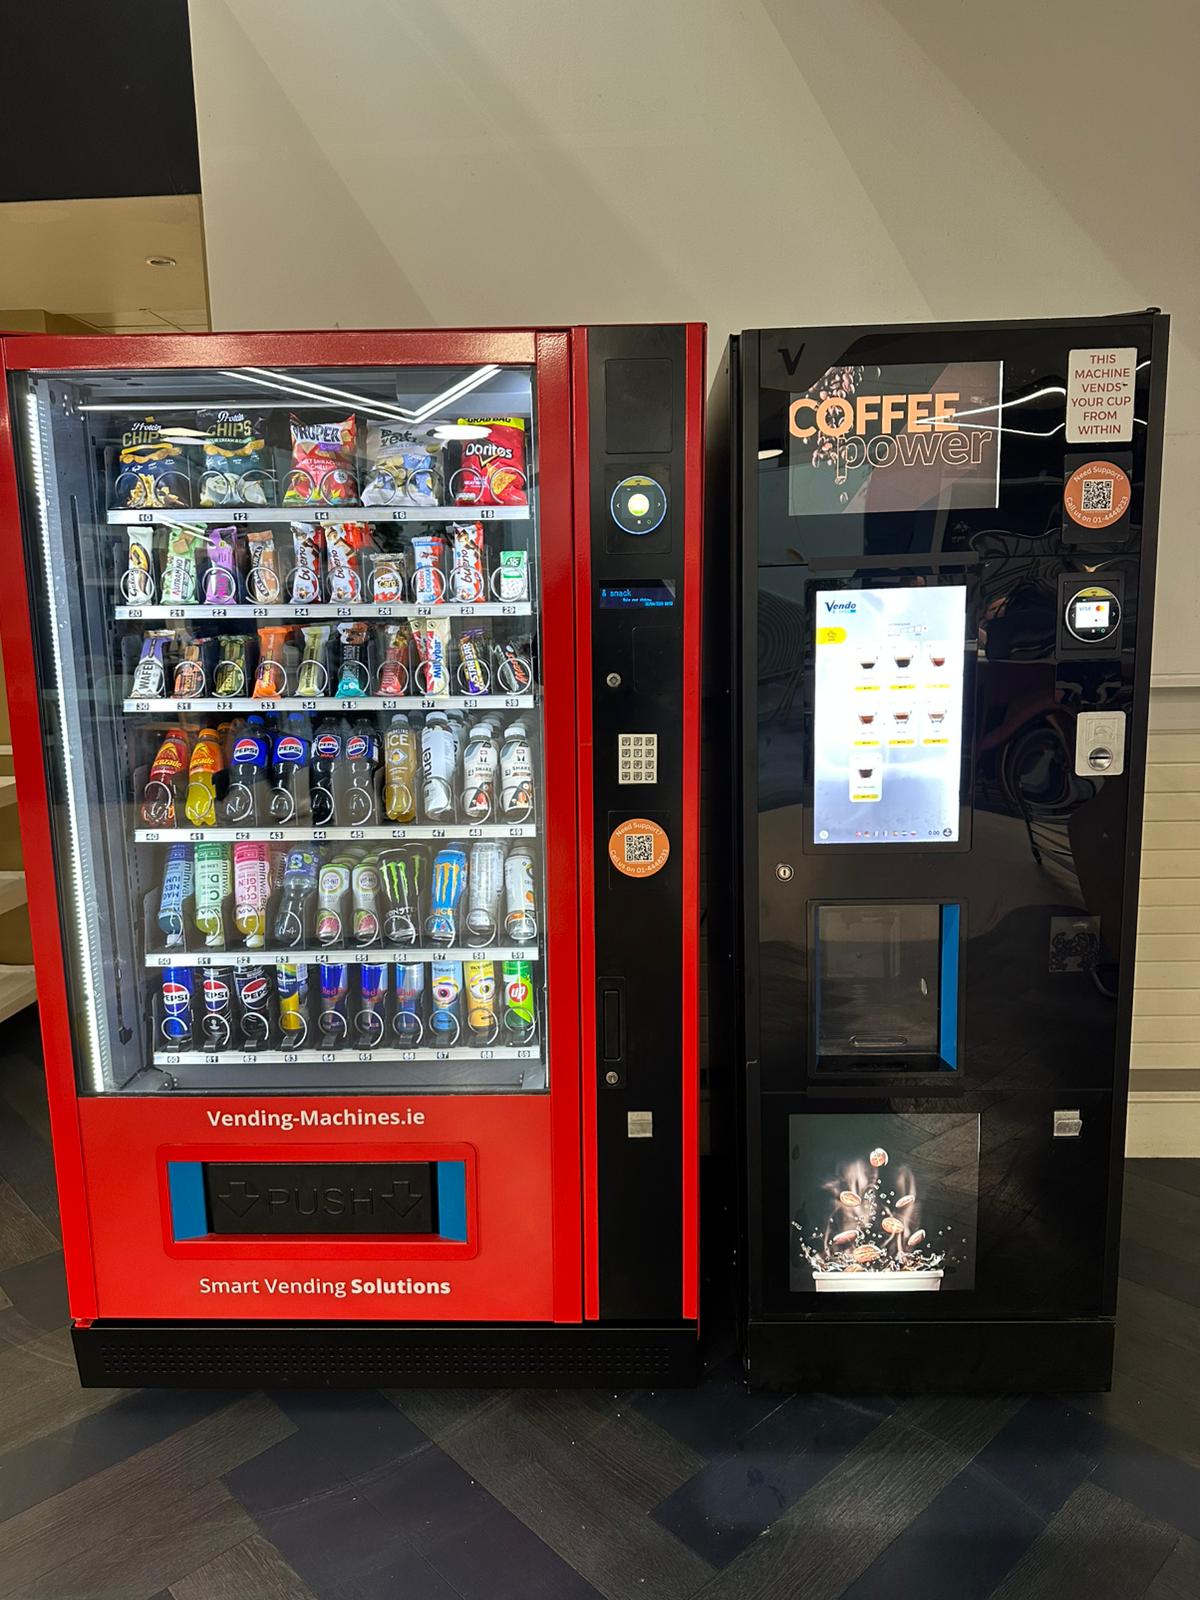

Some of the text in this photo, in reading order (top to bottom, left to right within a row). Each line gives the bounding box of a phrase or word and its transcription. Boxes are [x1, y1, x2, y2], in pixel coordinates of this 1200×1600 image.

[1090, 354, 1116, 364] THIS
[1075, 368, 1130, 379] MACHINE
[1081, 382, 1122, 393] VENDS
[1071, 396, 1131, 407] YOUR CUP
[217, 411, 245, 423] Protein
[789, 392, 960, 438] COFFEE
[1083, 411, 1117, 421] FROM
[207, 420, 252, 437] CHIPS
[1078, 424, 1121, 435] WITHIN
[466, 443, 513, 458] Doritos
[836, 431, 993, 478] power
[1073, 466, 1124, 482] Need Support?
[1066, 496, 1075, 512] Call
[1074, 511, 1082, 519] us
[140, 514, 152, 522] 10
[316, 512, 328, 520] 14
[299, 546, 311, 581] bueno
[331, 549, 345, 579] bueno
[460, 549, 472, 583] bueno
[252, 547, 268, 596] EAT NAURAL
[609, 589, 632, 597] snack
[825, 600, 857, 612] Vendo
[433, 640, 443, 679] Milkybar
[463, 642, 478, 682] STARBAR
[139, 659, 155, 690] WAFER
[387, 734, 410, 749] ICE
[235, 746, 258, 754] PEPSI
[279, 746, 302, 754] PEPSI
[236, 832, 249, 840] 42
[392, 830, 405, 838] 46
[510, 828, 522, 836] 49
[616, 822, 663, 837] Need Support?
[611, 849, 620, 863] Call
[243, 988, 267, 1000] PEPS
[207, 1109, 425, 1131] Vending-Machines.ie
[268, 1187, 375, 1216] PUSH
[199, 1277, 451, 1298] Smart Vending Solutions
